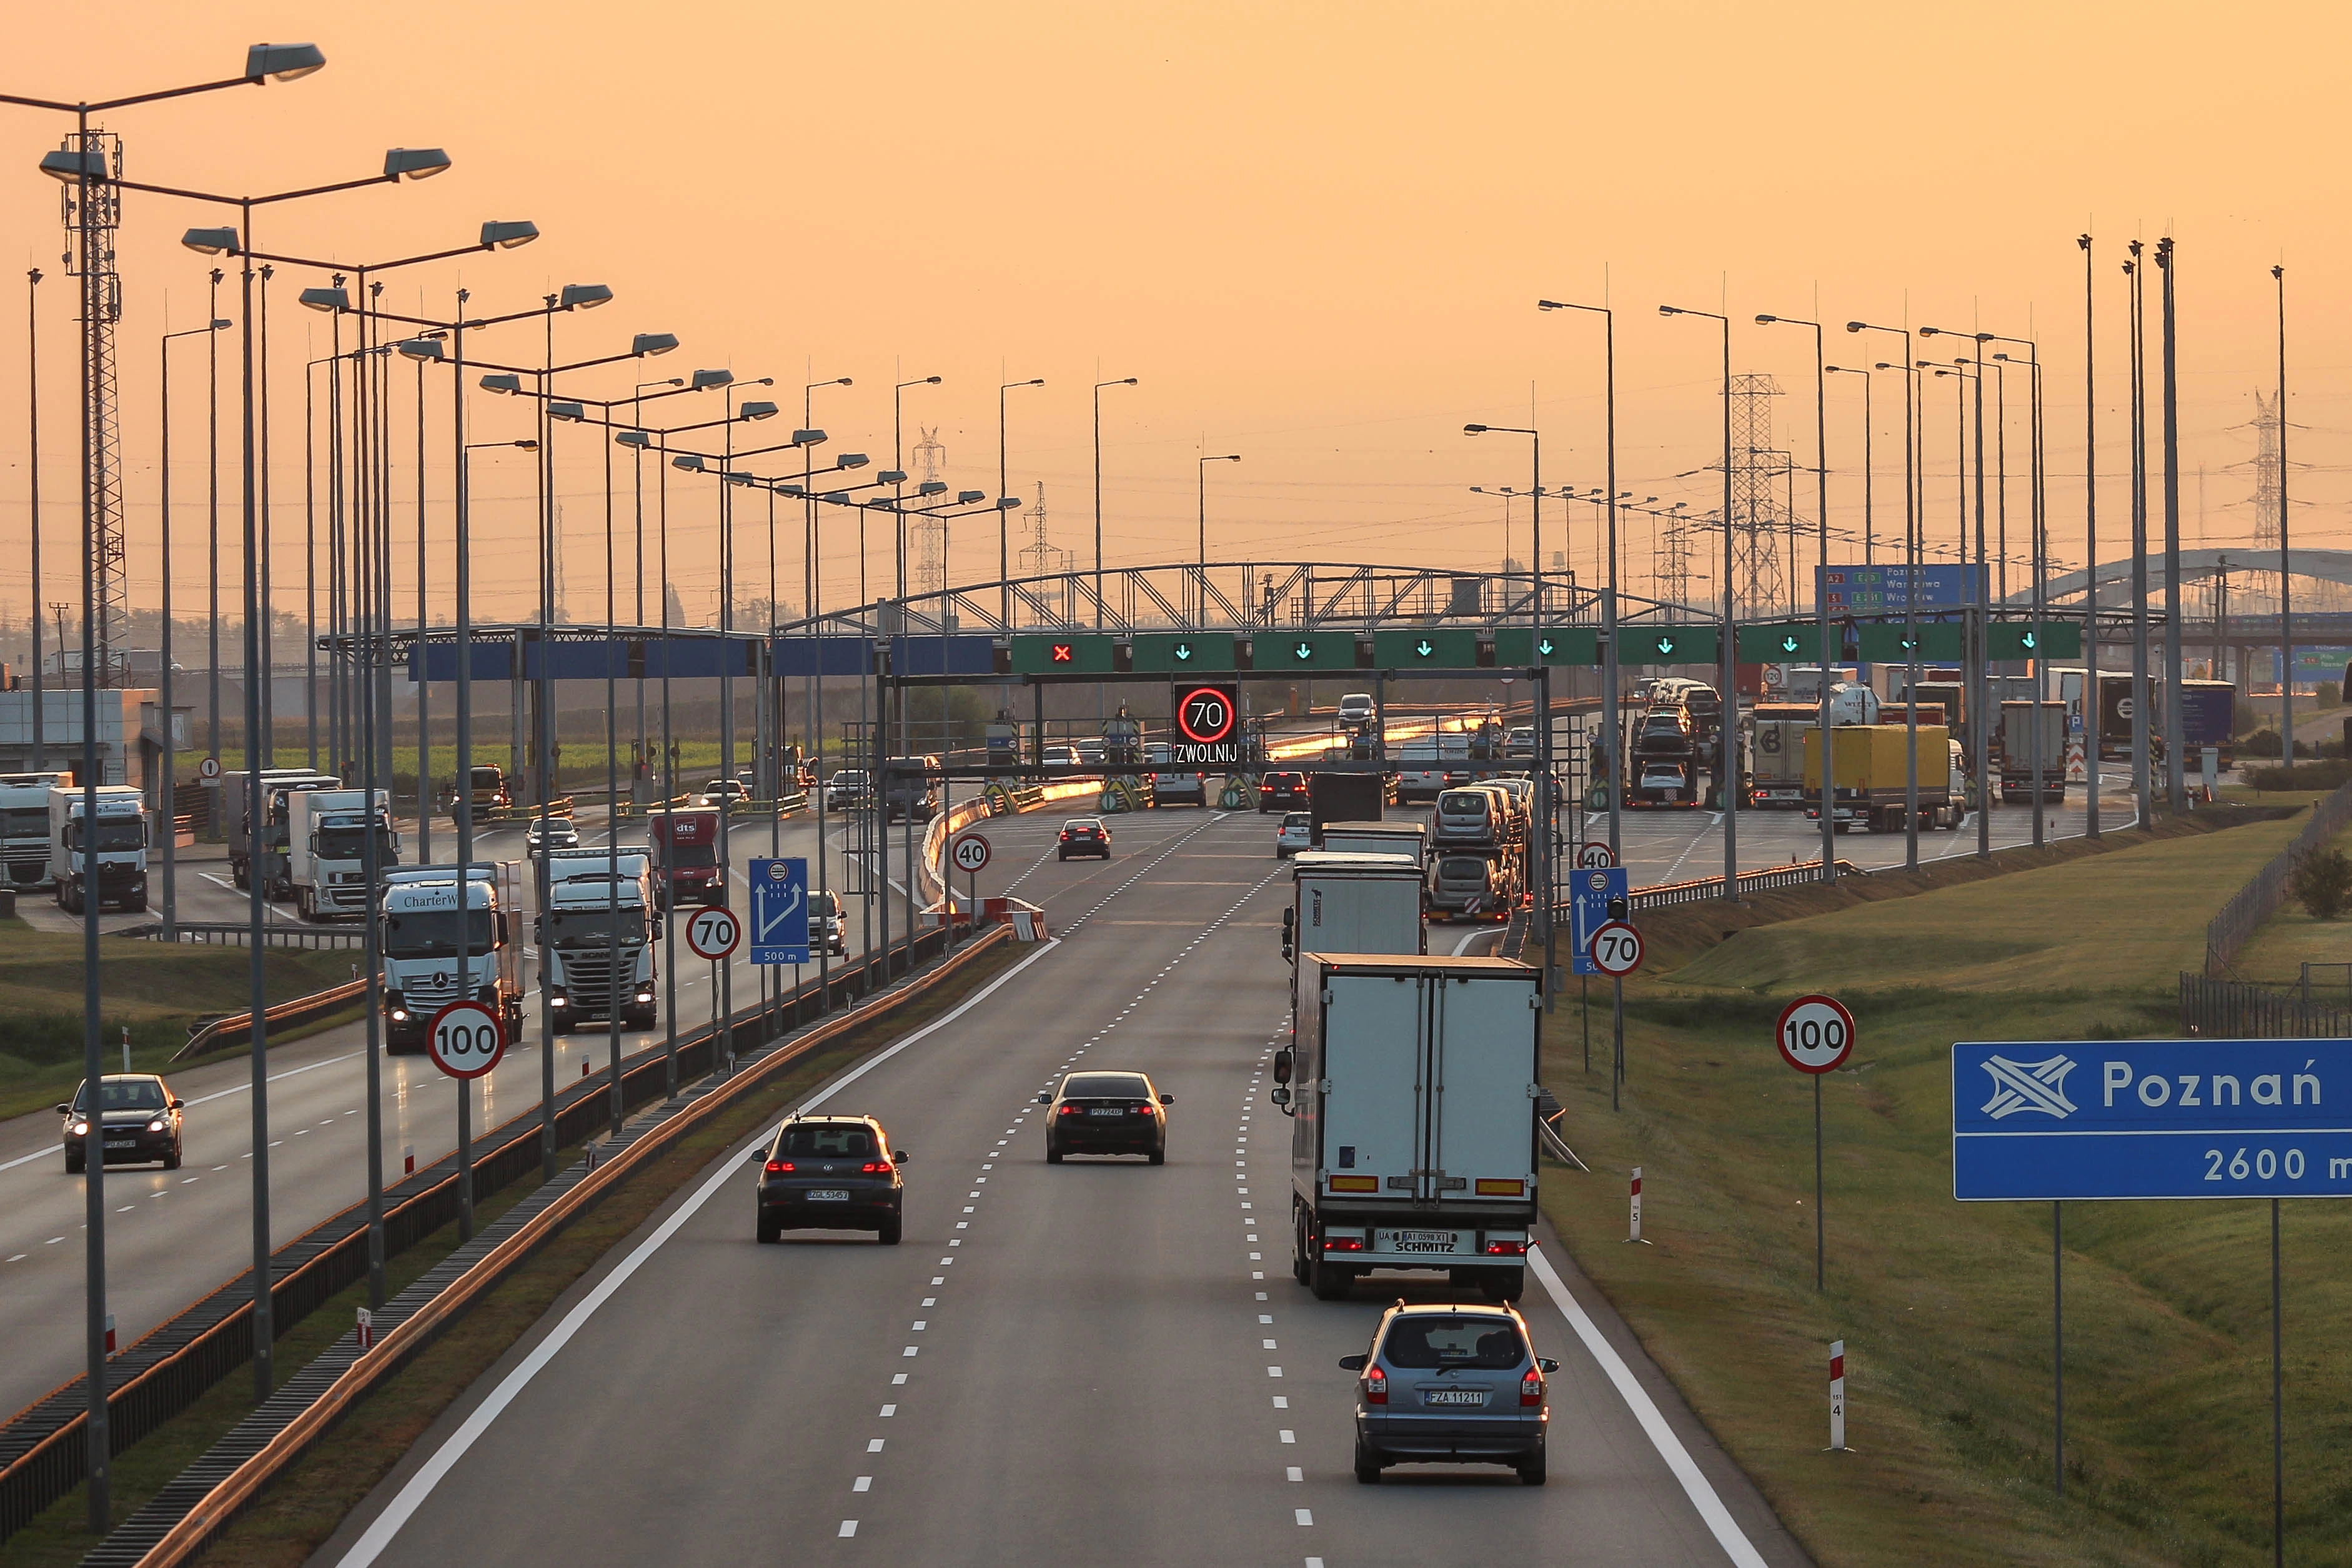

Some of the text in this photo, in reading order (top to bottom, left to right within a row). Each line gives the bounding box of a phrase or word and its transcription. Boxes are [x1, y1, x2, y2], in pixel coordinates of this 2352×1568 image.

[1191, 702, 1223, 727] 70
[1176, 743, 1237, 762] ZWOLNIJ
[960, 845, 984, 862] 40
[1584, 852, 1609, 868] 40
[698, 920, 733, 946] 70
[765, 951, 785, 961] 500
[1602, 936, 1636, 961] 70
[437, 1025, 495, 1055] 100
[1785, 1020, 1844, 1050] 100
[2103, 1059, 2321, 1107] Poznań
[2204, 1148, 2352, 1180] 2600 m
[1632, 1213, 1639, 1221] 5
[1379, 1232, 1390, 1240] UA
[1395, 1242, 1455, 1253] SCHMITZ
[1430, 1392, 1481, 1402] FZA 11211
[1832, 1405, 1841, 1416] 4
